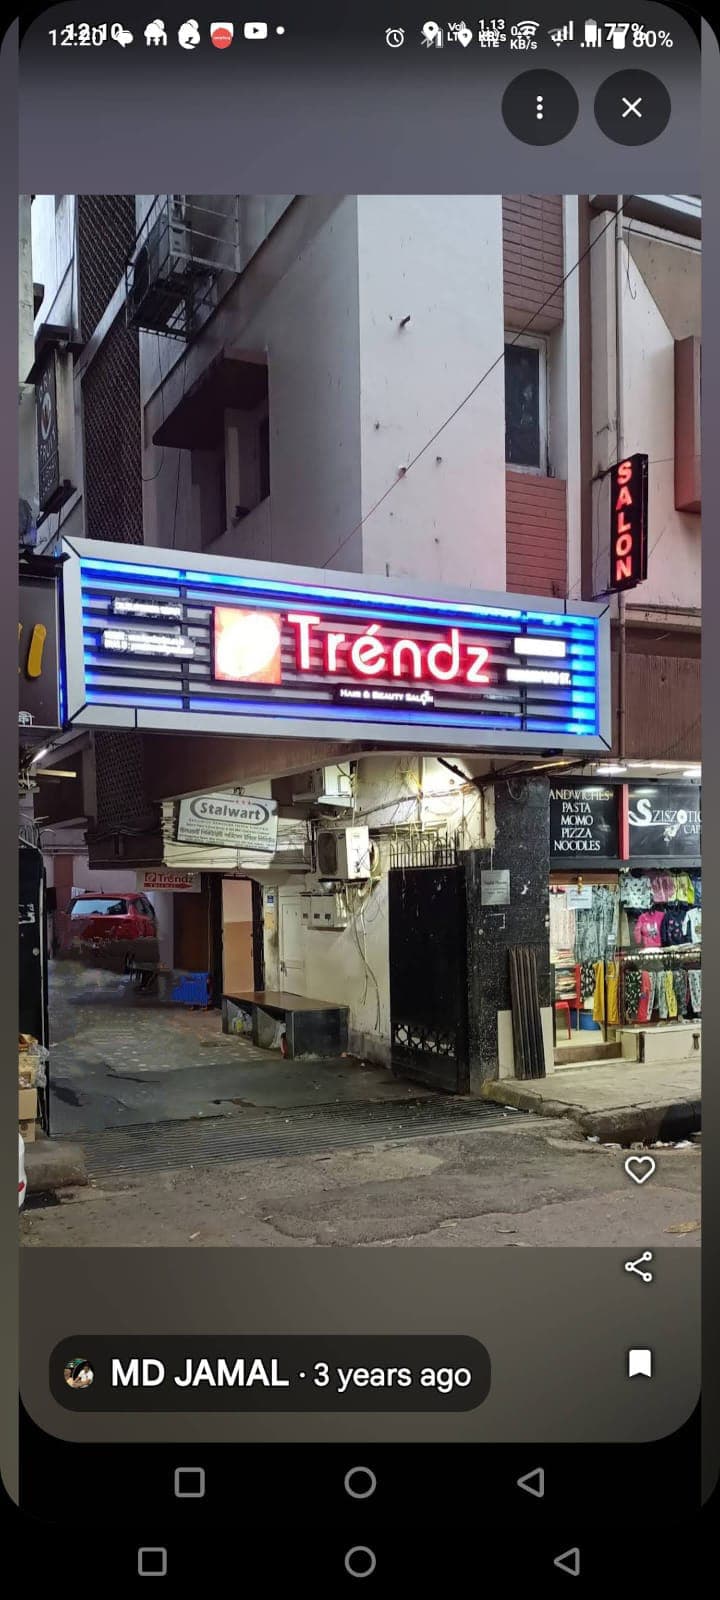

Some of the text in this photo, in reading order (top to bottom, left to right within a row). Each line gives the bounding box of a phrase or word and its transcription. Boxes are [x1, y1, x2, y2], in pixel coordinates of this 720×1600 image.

[615, 460, 633, 581] SALON
[287, 613, 491, 684] Tréndz
[549, 788, 610, 801] ANDWICHES
[200, 801, 261, 820] Stalwart
[562, 802, 592, 813] PASTA
[560, 815, 594, 826] MOMO
[561, 828, 593, 839] PIZZA
[554, 840, 601, 851] NOODLES
